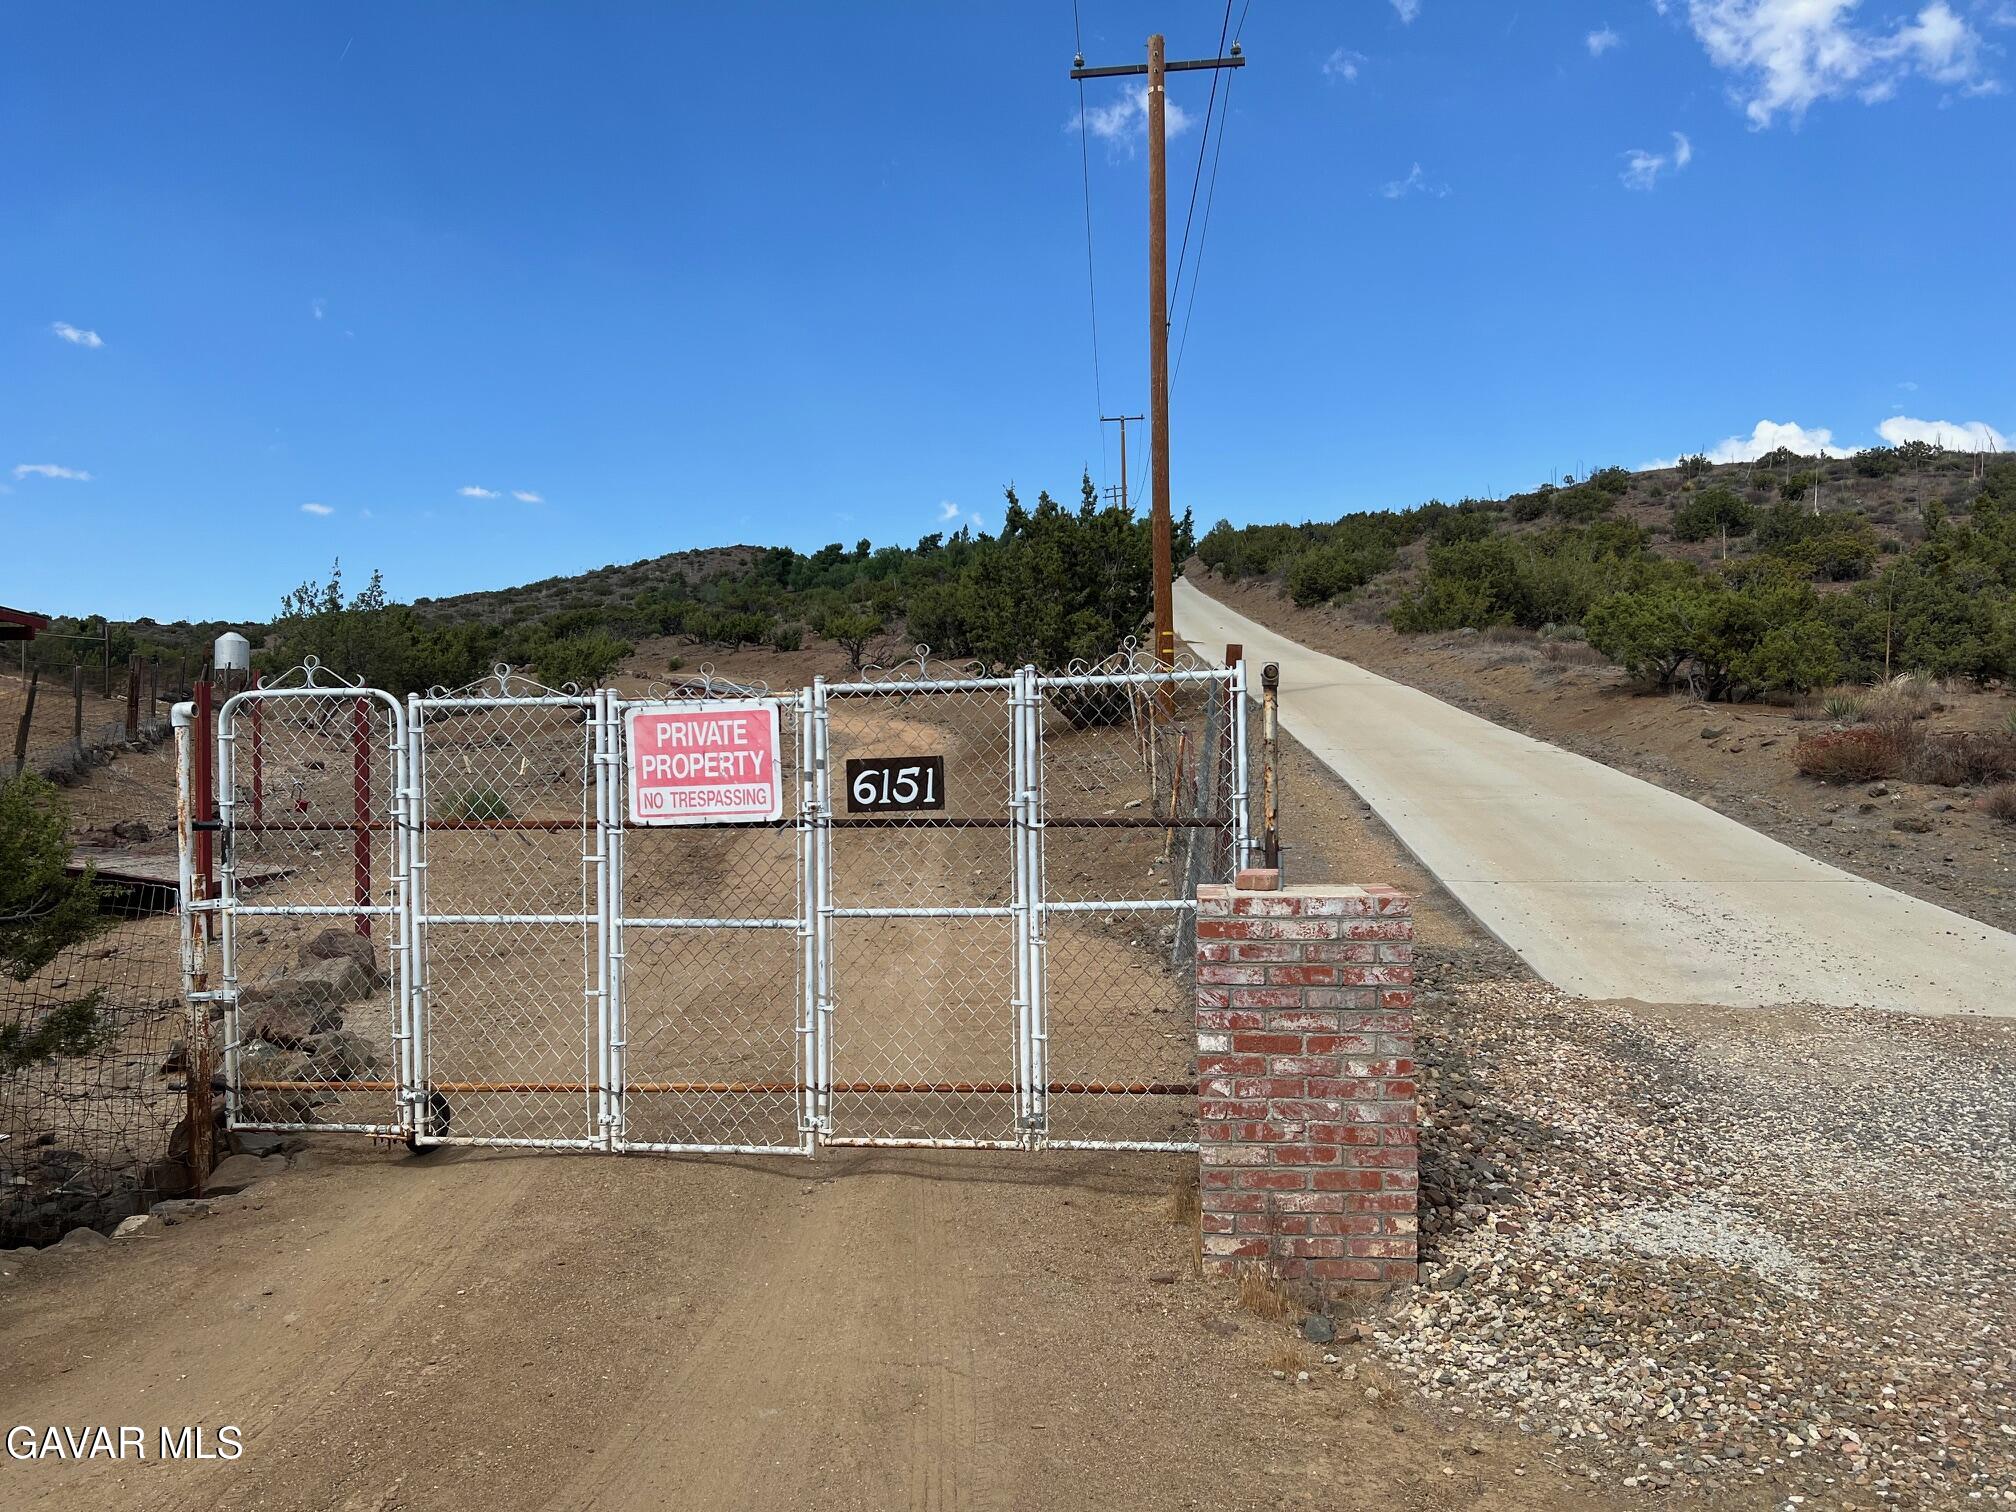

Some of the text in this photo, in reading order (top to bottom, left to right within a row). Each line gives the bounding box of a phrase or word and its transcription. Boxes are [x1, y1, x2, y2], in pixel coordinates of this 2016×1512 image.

[656, 719, 748, 748] PRIVATE
[642, 750, 764, 780] PROPERTY
[644, 788, 767, 810] NO TRESPASSING
[853, 766, 936, 805] 6151
